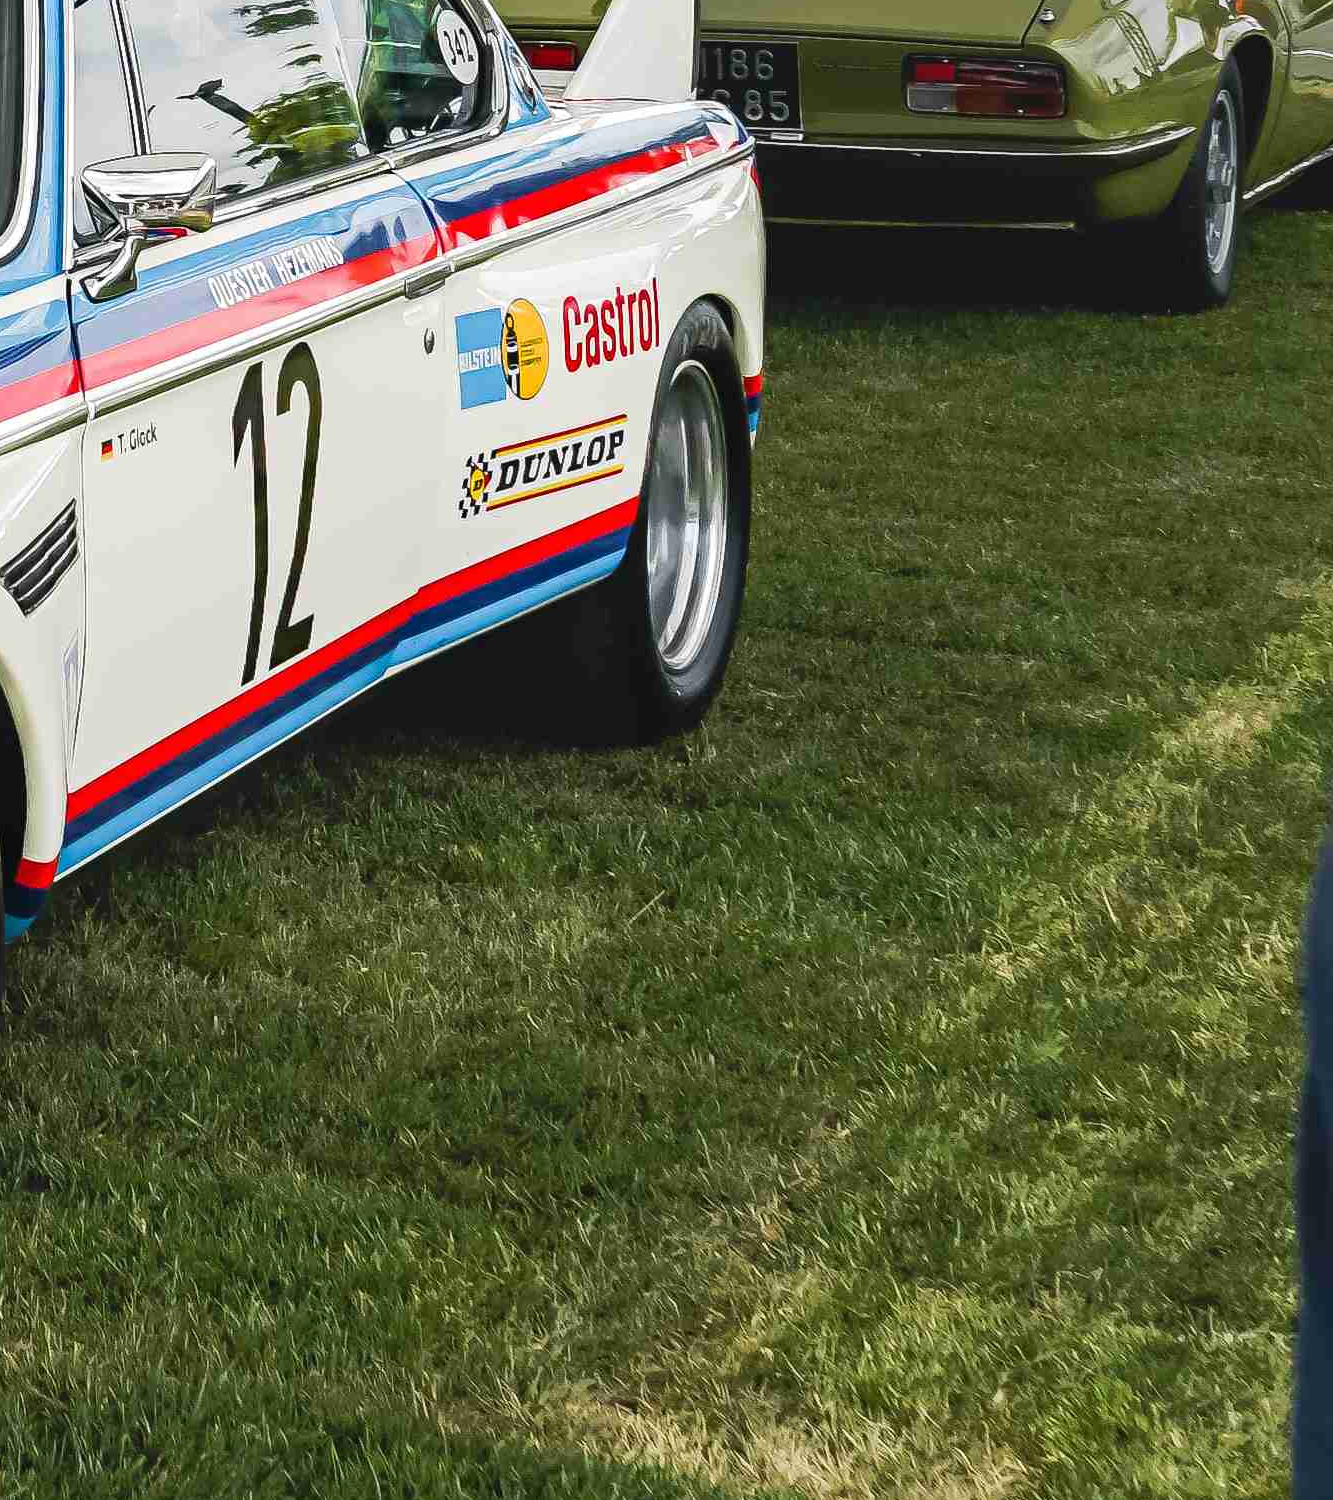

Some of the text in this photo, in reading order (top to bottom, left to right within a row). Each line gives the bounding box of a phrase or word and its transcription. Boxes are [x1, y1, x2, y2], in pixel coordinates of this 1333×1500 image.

[443, 27, 474, 66] 342
[208, 236, 344, 308] QUESTER HEZEMANS
[563, 277, 660, 373] Castrol
[117, 433, 127, 454] T.
[496, 430, 624, 492] DUNLOP
[232, 341, 322, 687] 12
